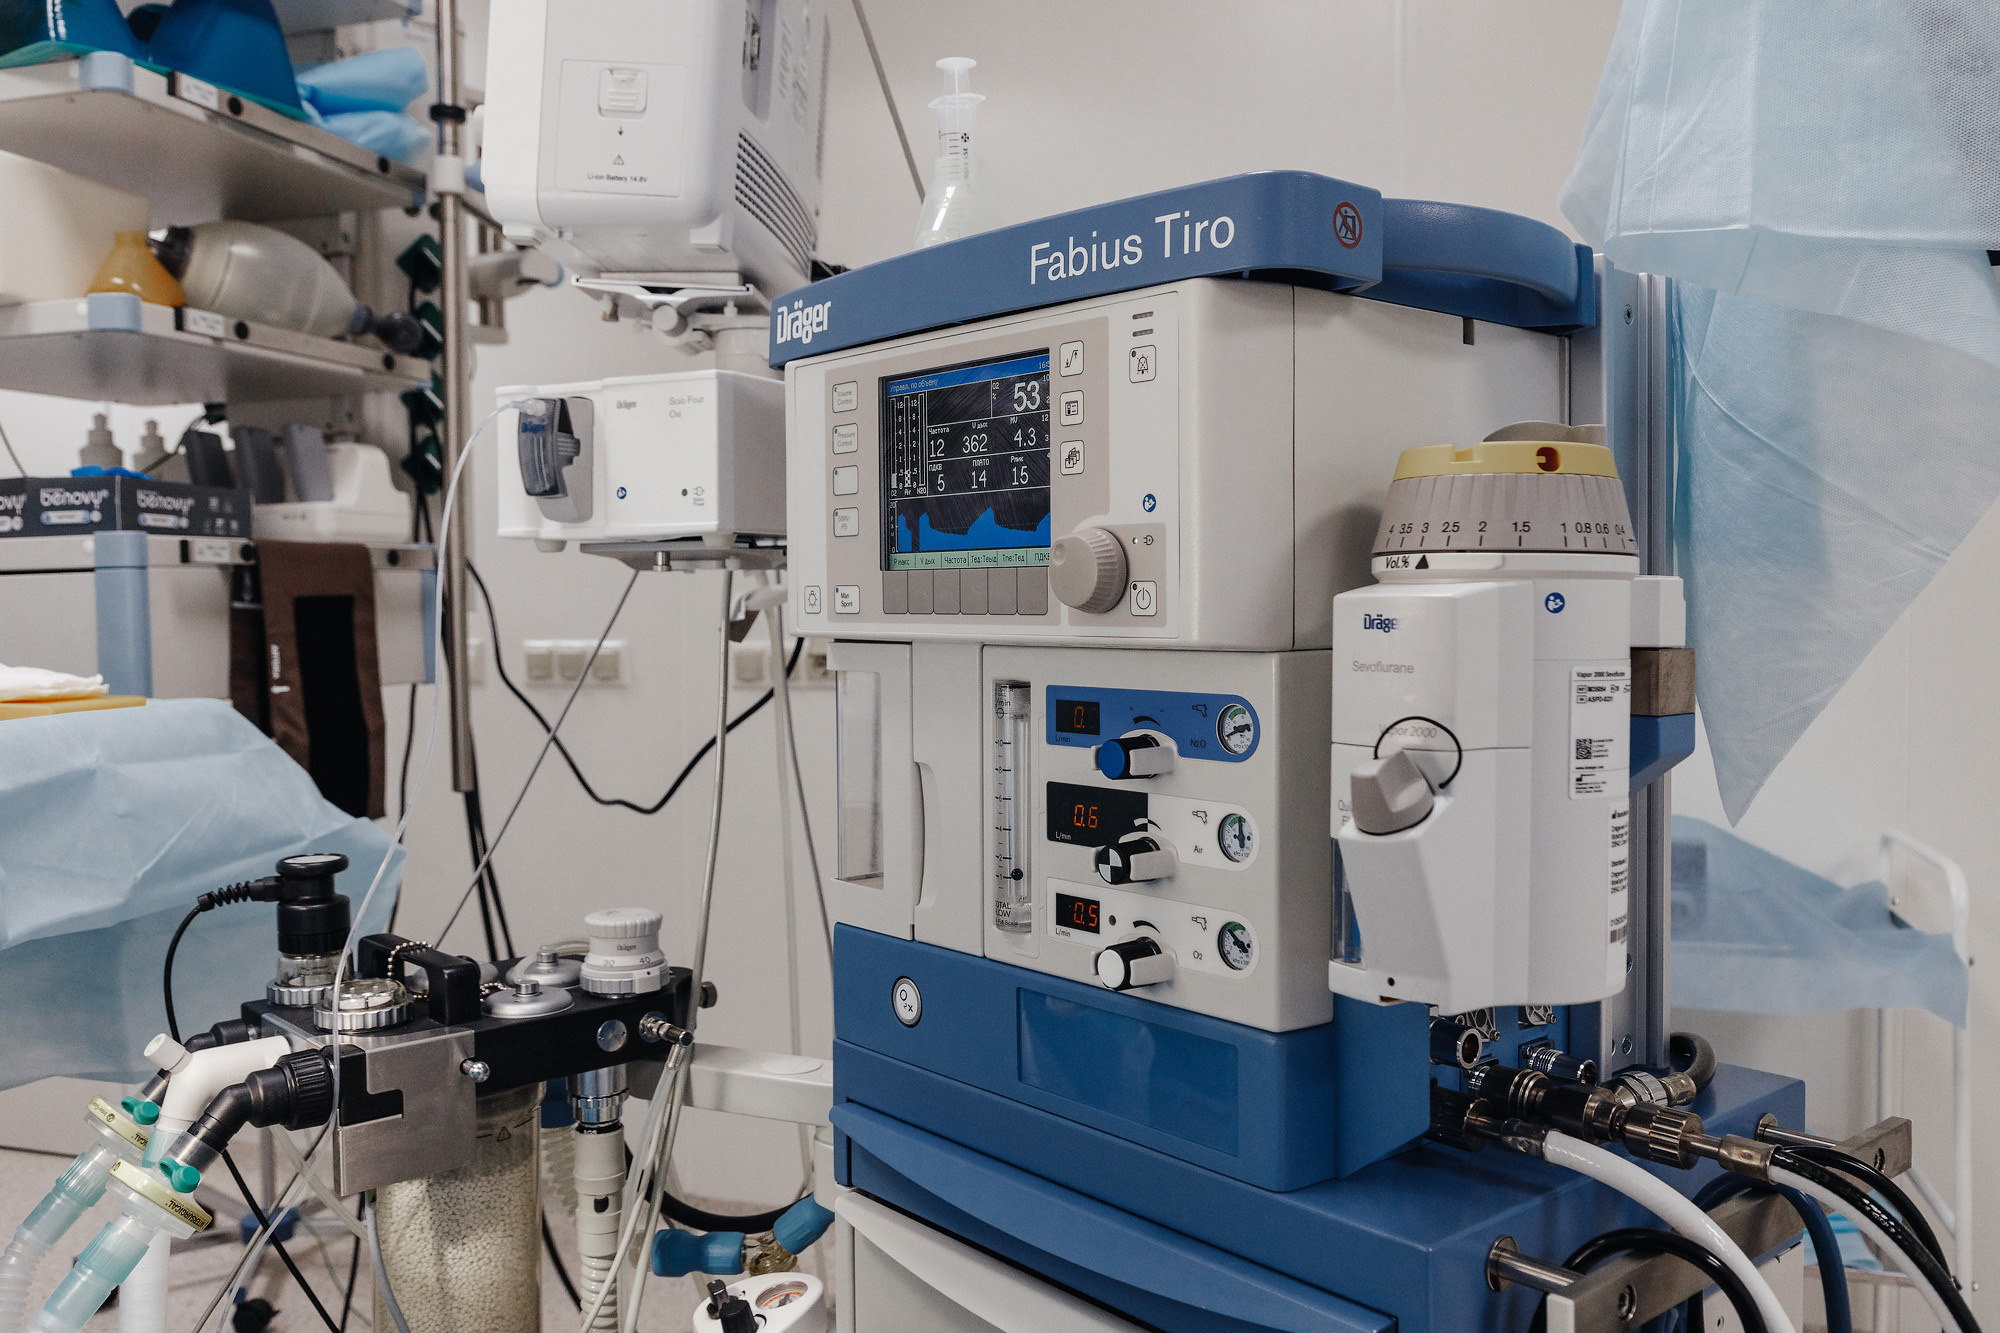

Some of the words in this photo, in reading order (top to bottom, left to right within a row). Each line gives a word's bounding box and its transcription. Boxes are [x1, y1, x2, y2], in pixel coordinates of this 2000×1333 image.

[1030, 231, 1143, 285] Fabius
[1154, 210, 1236, 258] Tiro
[776, 299, 831, 344] Dräger
[668, 396, 686, 406] Scio
[837, 397, 853, 406] Control
[1014, 380, 1041, 412] 53
[911, 399, 918, 407] 12
[1041, 414, 1049, 422] 12
[928, 427, 950, 435] Частота
[837, 439, 853, 447] Control
[1013, 427, 1037, 448] 4.3
[929, 438, 945, 458] 12
[962, 434, 988, 453] 362
[928, 463, 943, 472] ПДКВ
[972, 458, 990, 467] ПЛАТО
[971, 469, 987, 489] 14
[1012, 465, 1029, 486] 15
[937, 474, 946, 491] 5
[1389, 524, 1395, 535] 4
[1399, 522, 1413, 535] 3.5
[1421, 522, 1430, 534] 3
[1441, 521, 1460, 533] 2.5
[1478, 521, 1487, 532] 2
[1512, 521, 1531, 533] 1.5
[1560, 522, 1567, 533] 1
[1575, 522, 1592, 534] 0.8
[1595, 522, 1610, 535] 0.6
[944, 556, 967, 565] Частота
[840, 600, 853, 609] Spont
[1363, 613, 1401, 633] Dräge
[1352, 660, 1415, 674] Sevoflurane
[1410, 726, 1438, 739] 2000
[1055, 735, 1071, 744] L/min
[1190, 738, 1207, 749] N2O
[1073, 804, 1098, 828] 0.6
[1055, 831, 1072, 841] L/min
[1193, 845, 1204, 854] Air
[995, 900, 1012, 910] OTAL
[995, 909, 1012, 918] LOW
[1073, 901, 1098, 927] 0.5
[1055, 927, 1071, 938] L/min
[1192, 950, 1203, 961] O2
[603, 959, 616, 967] 30
[639, 956, 651, 964] 40
